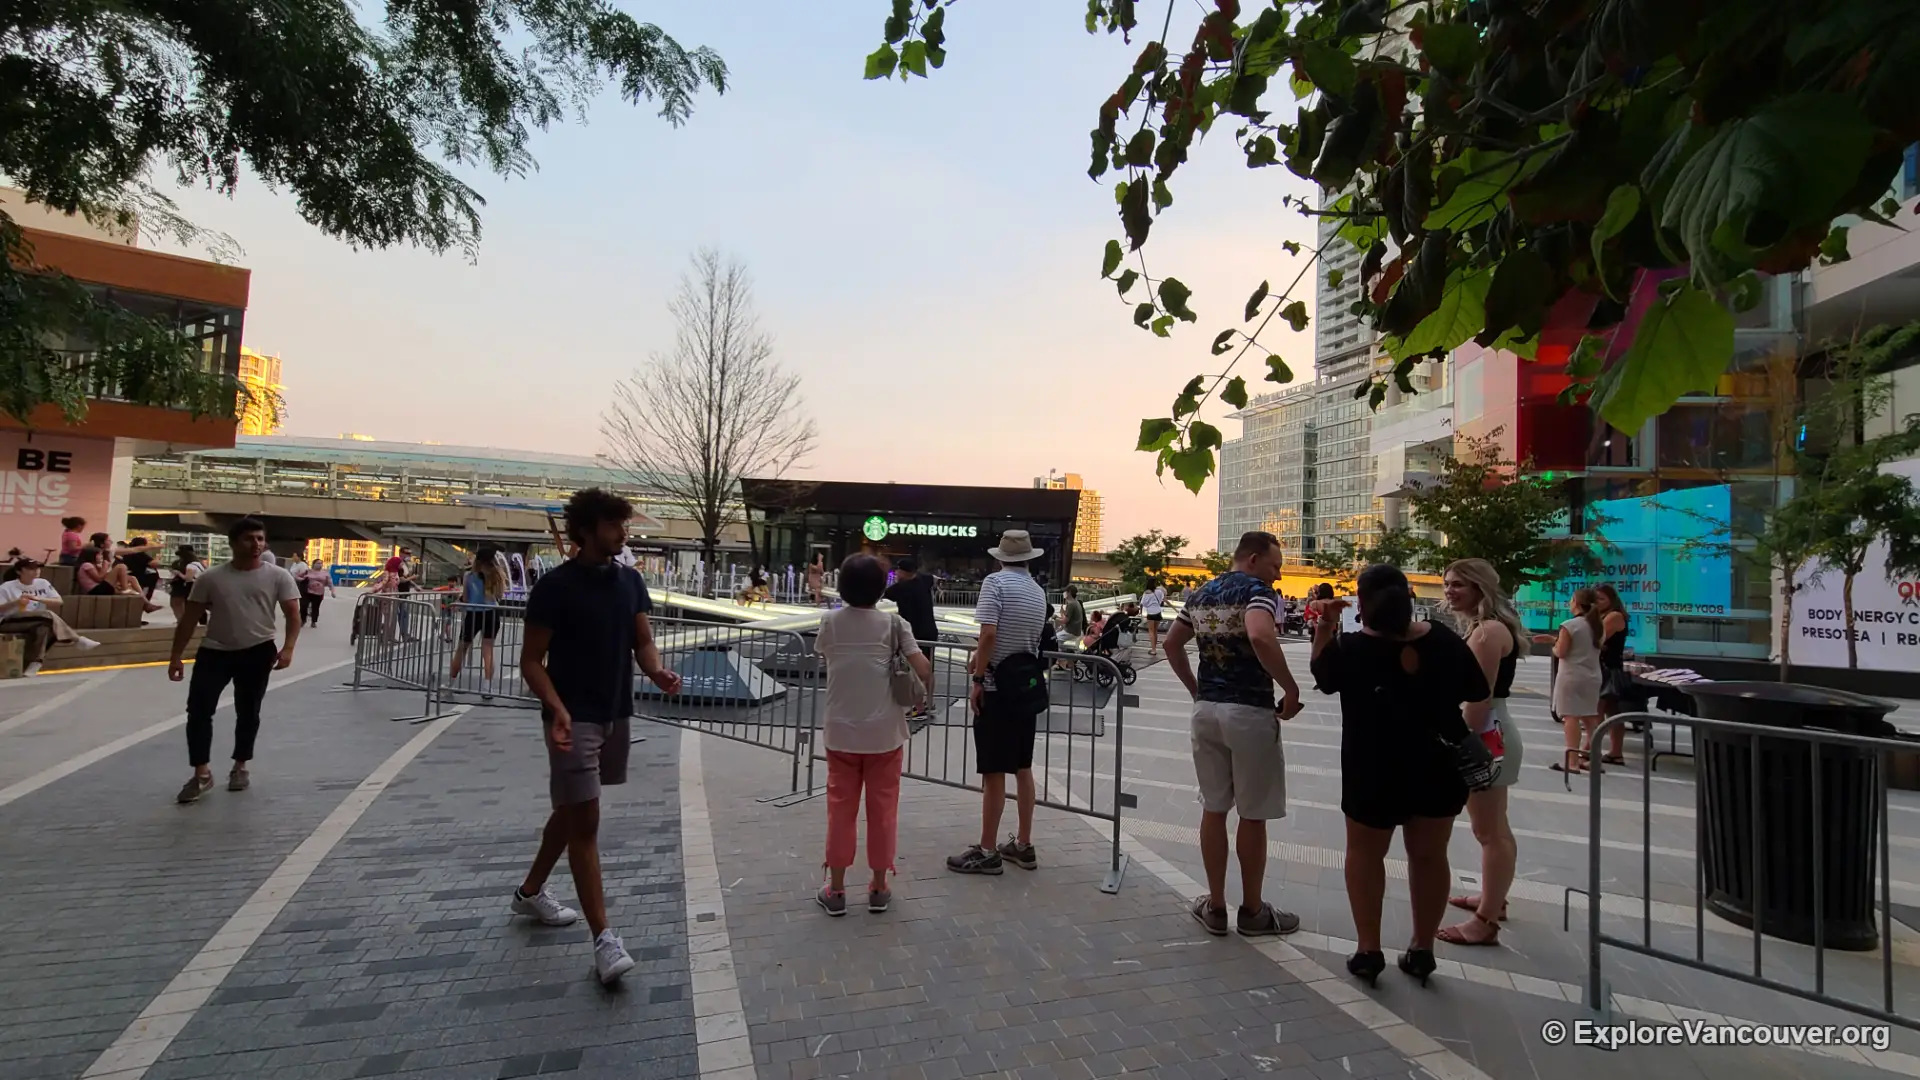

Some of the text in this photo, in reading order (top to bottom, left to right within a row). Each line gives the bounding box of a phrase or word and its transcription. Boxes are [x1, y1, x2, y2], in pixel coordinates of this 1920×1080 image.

[17, 448, 73, 474] BE
[888, 523, 977, 537] STARBUCKS
[1808, 608, 1843, 621] BODY
[1849, 610, 1905, 624] NERGY
[1897, 632, 1920, 646] RB
